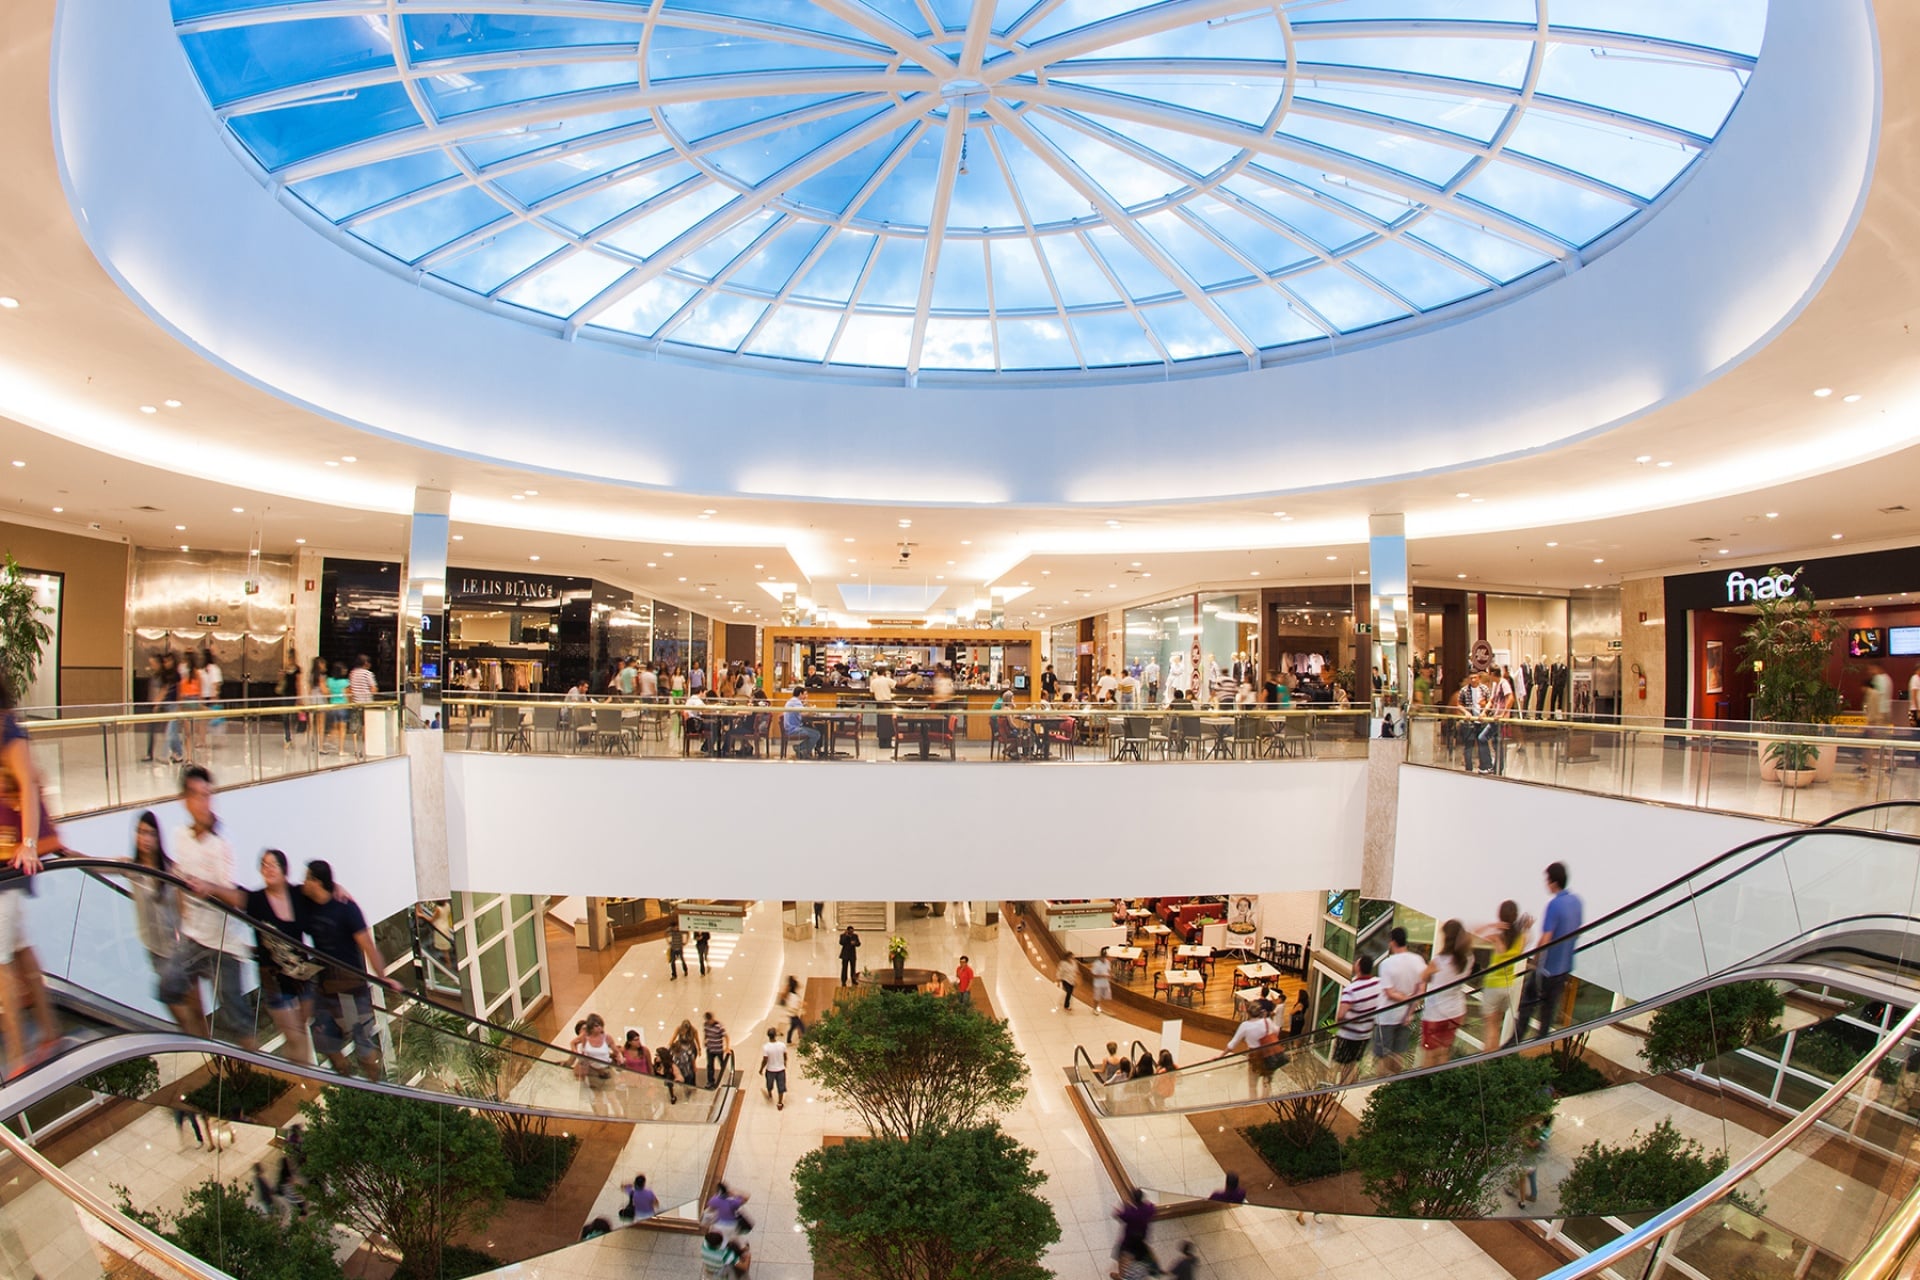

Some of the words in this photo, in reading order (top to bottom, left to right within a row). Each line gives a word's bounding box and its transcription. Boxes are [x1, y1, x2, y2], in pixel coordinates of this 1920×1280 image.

[462, 578, 478, 593] LE
[482, 580, 501, 595] LIS
[505, 582, 546, 598] BLANC
[1726, 571, 1795, 602] fnac
